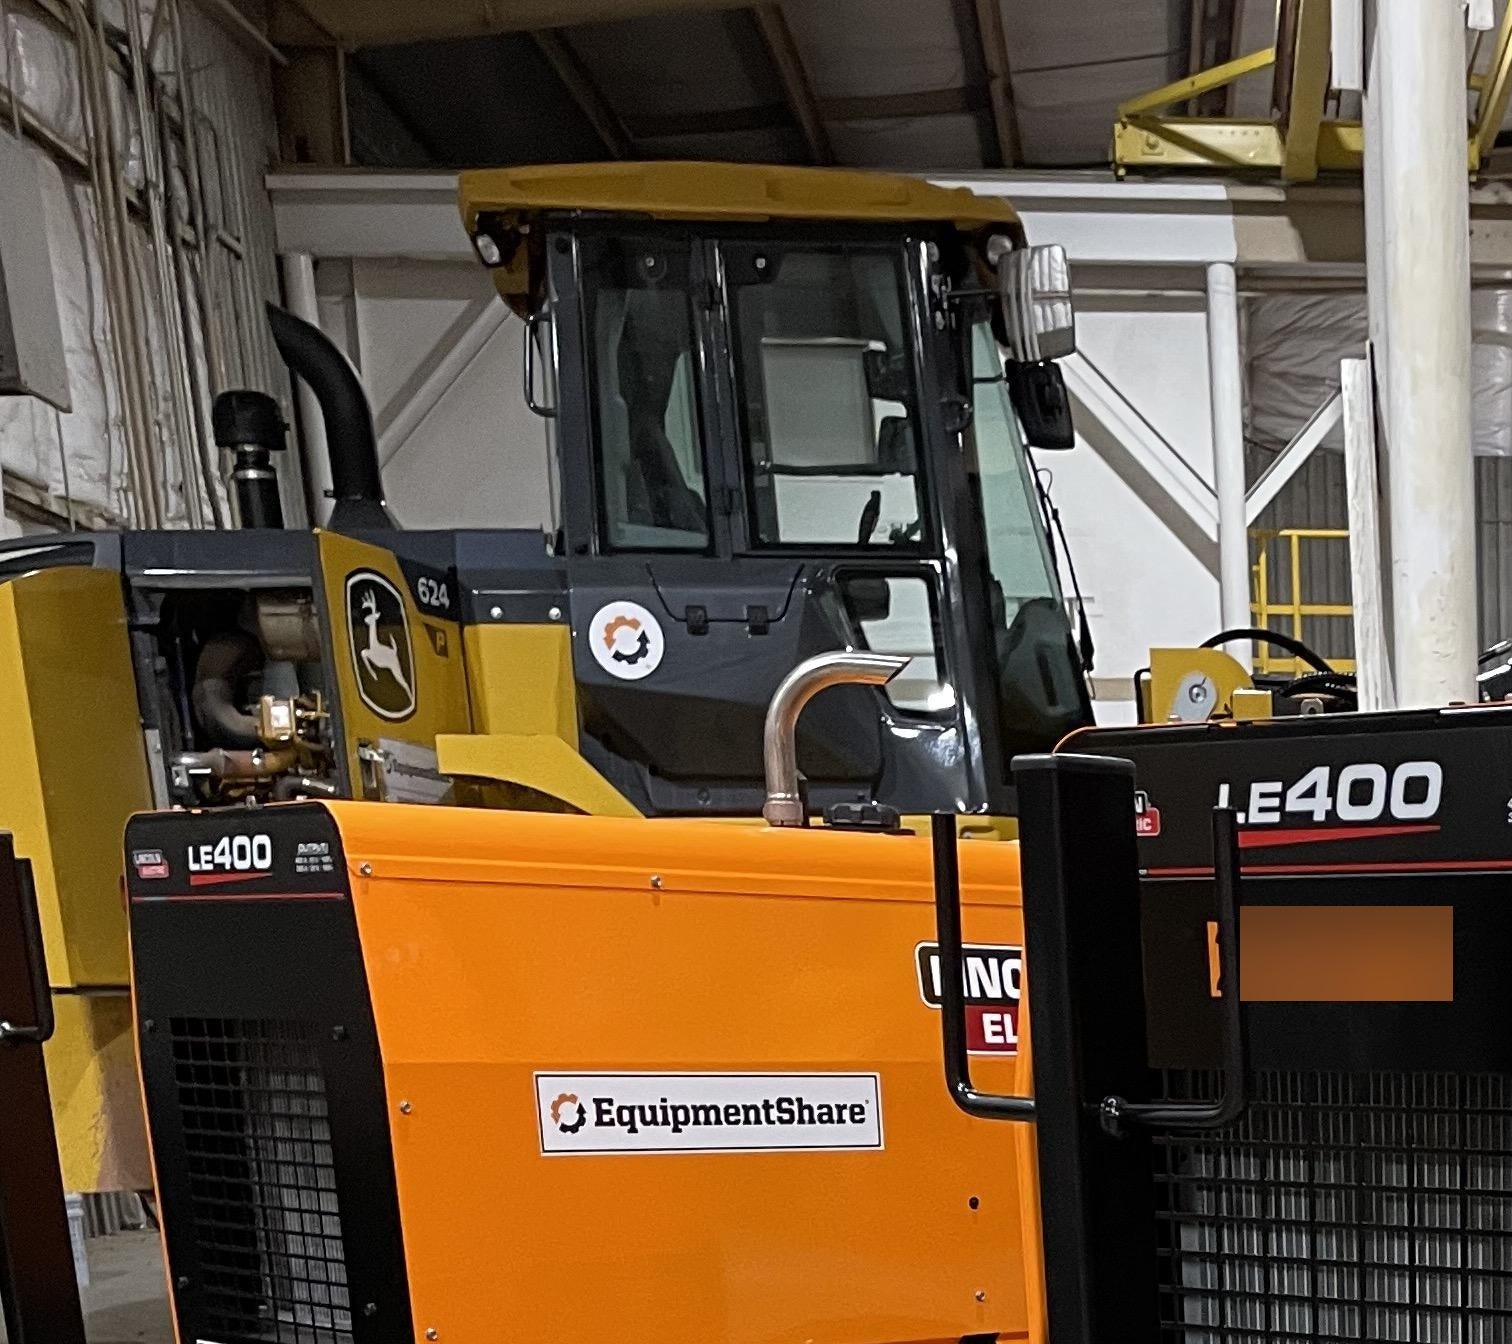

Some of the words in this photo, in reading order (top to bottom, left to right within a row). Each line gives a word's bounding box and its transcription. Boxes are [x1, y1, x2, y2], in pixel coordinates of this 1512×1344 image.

[418, 577, 450, 609] 624
[1218, 761, 1443, 824] LE400
[188, 834, 271, 871] LE400
[593, 1097, 866, 1134] EquipmentShare
